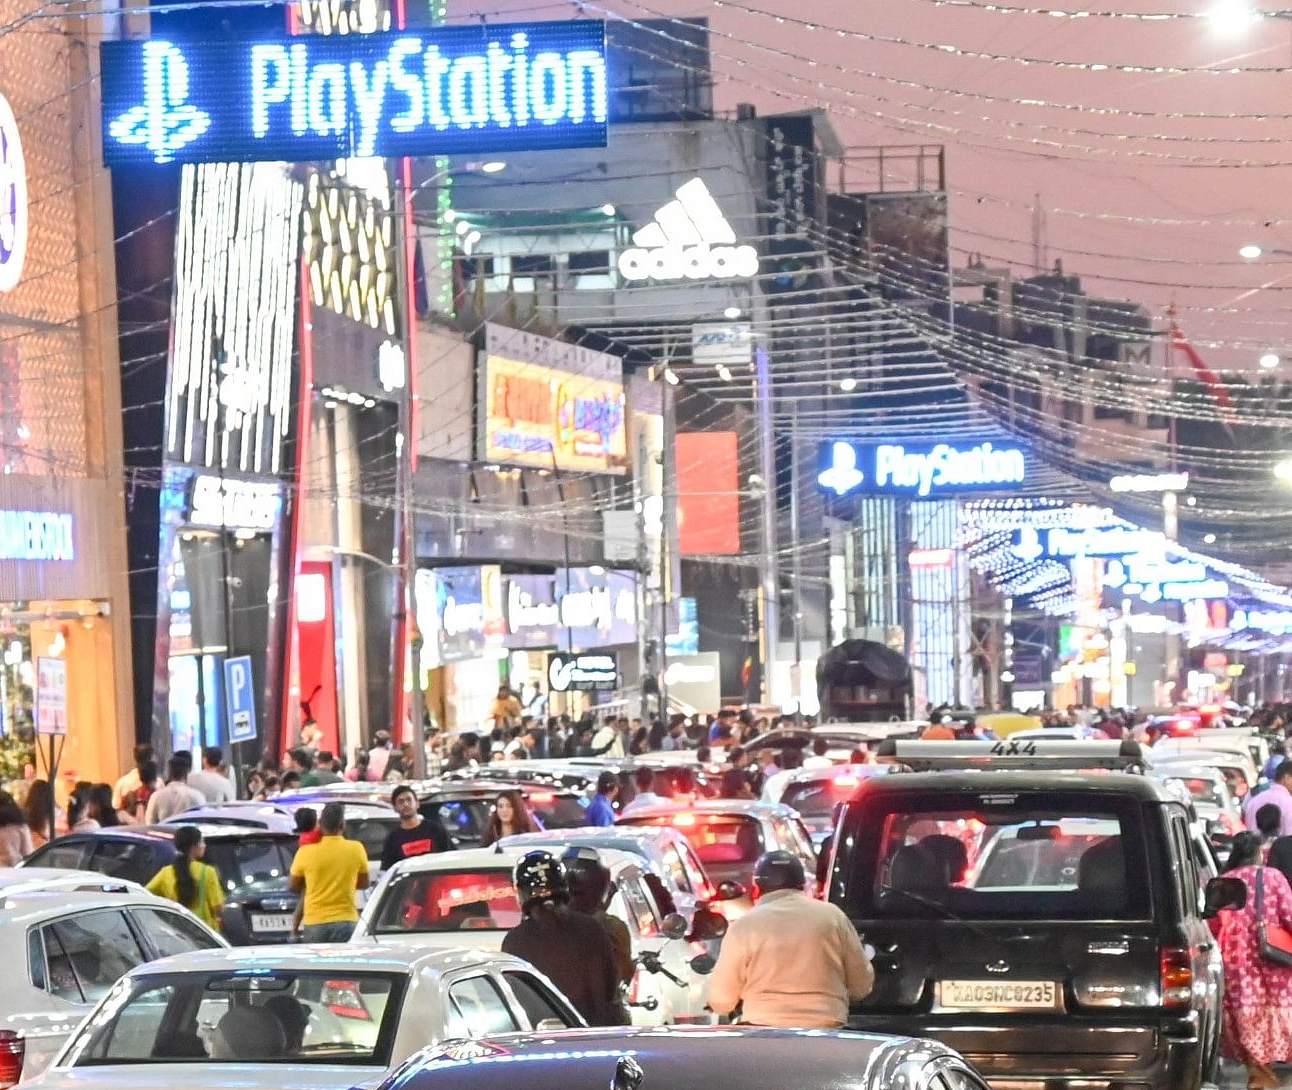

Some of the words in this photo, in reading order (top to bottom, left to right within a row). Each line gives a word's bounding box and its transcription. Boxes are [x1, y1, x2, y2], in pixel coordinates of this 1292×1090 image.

[251, 32, 608, 157] PlayStation
[618, 243, 759, 280] adidas
[875, 442, 1025, 496] PlayStation
[231, 664, 246, 710] P
